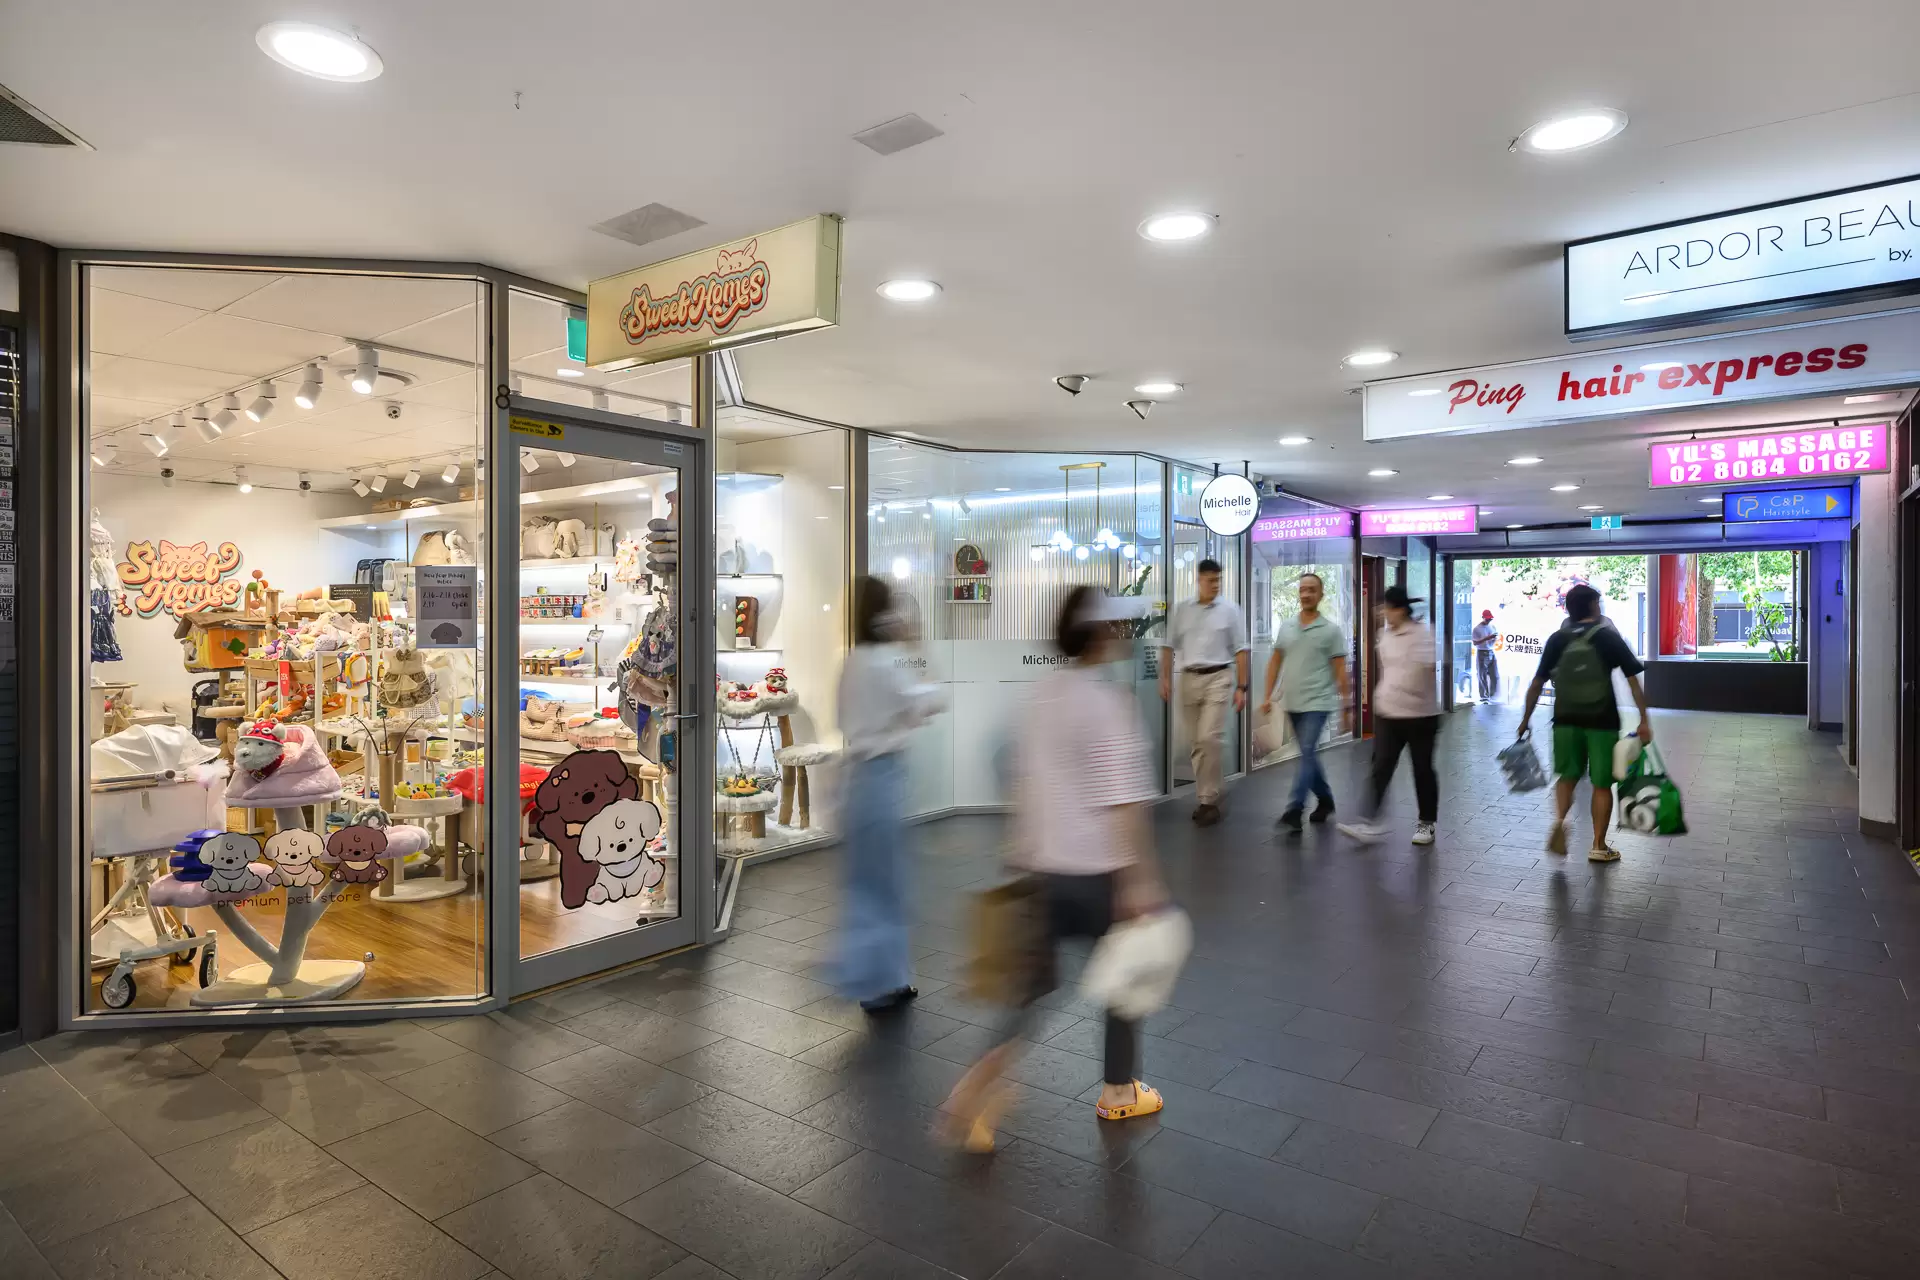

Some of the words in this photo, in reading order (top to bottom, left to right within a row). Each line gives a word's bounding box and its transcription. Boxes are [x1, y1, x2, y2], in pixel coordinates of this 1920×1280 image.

[1623, 225, 1784, 280] ARDOR
[1888, 247, 1913, 263] by.
[626, 287, 692, 339] Sweet
[688, 267, 766, 329] Homes
[1447, 378, 1527, 415] Ping
[1557, 363, 1646, 402] hair
[1657, 343, 1869, 396] express
[495, 384, 510, 409] 8
[1666, 443, 1727, 465] YU'S
[1737, 429, 1873, 459] MASSAGE
[1669, 463, 1702, 483] 02
[1713, 457, 1787, 480] 8084
[1798, 450, 1871, 473] 0162
[1204, 496, 1251, 509] Michelle
[1770, 495, 1804, 507] C&P
[1763, 507, 1811, 517] Hairstyle
[116, 540, 241, 587] Sweet
[135, 579, 242, 618] Homes
[1505, 634, 1539, 645] OPlus
[893, 657, 927, 669] Michelle
[1022, 654, 1069, 665] Michelle
[217, 895, 280, 909] premium
[287, 895, 312, 906] pet
[320, 891, 361, 904] store
